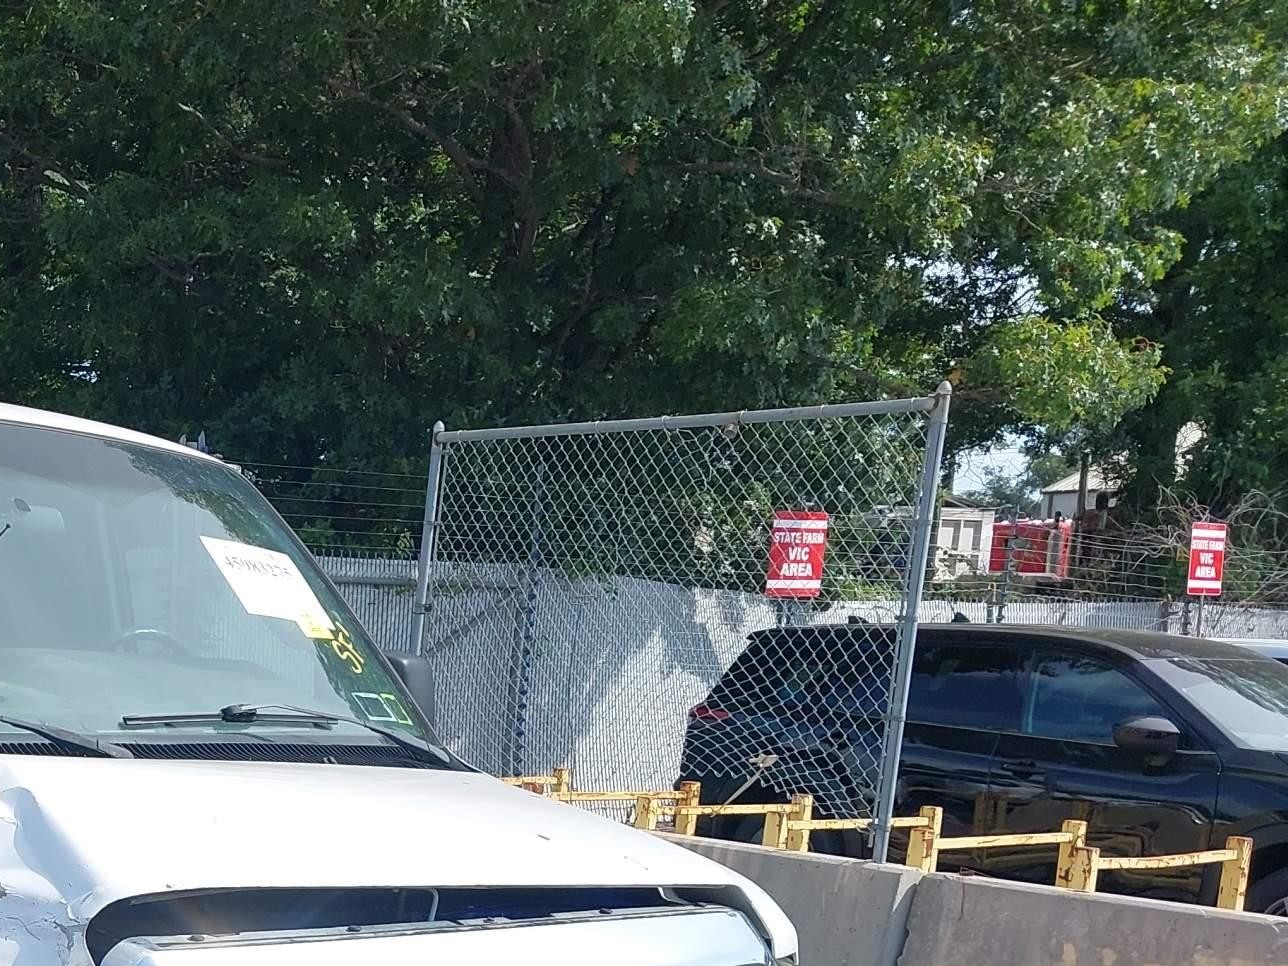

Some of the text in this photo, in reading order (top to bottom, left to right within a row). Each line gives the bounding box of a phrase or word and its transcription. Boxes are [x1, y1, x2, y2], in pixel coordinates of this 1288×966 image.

[774, 532, 825, 544] STATE FARM
[788, 547, 810, 561] VIC
[1200, 552, 1214, 564] VIC
[780, 563, 813, 577] AREA
[1195, 566, 1217, 578] AREA
